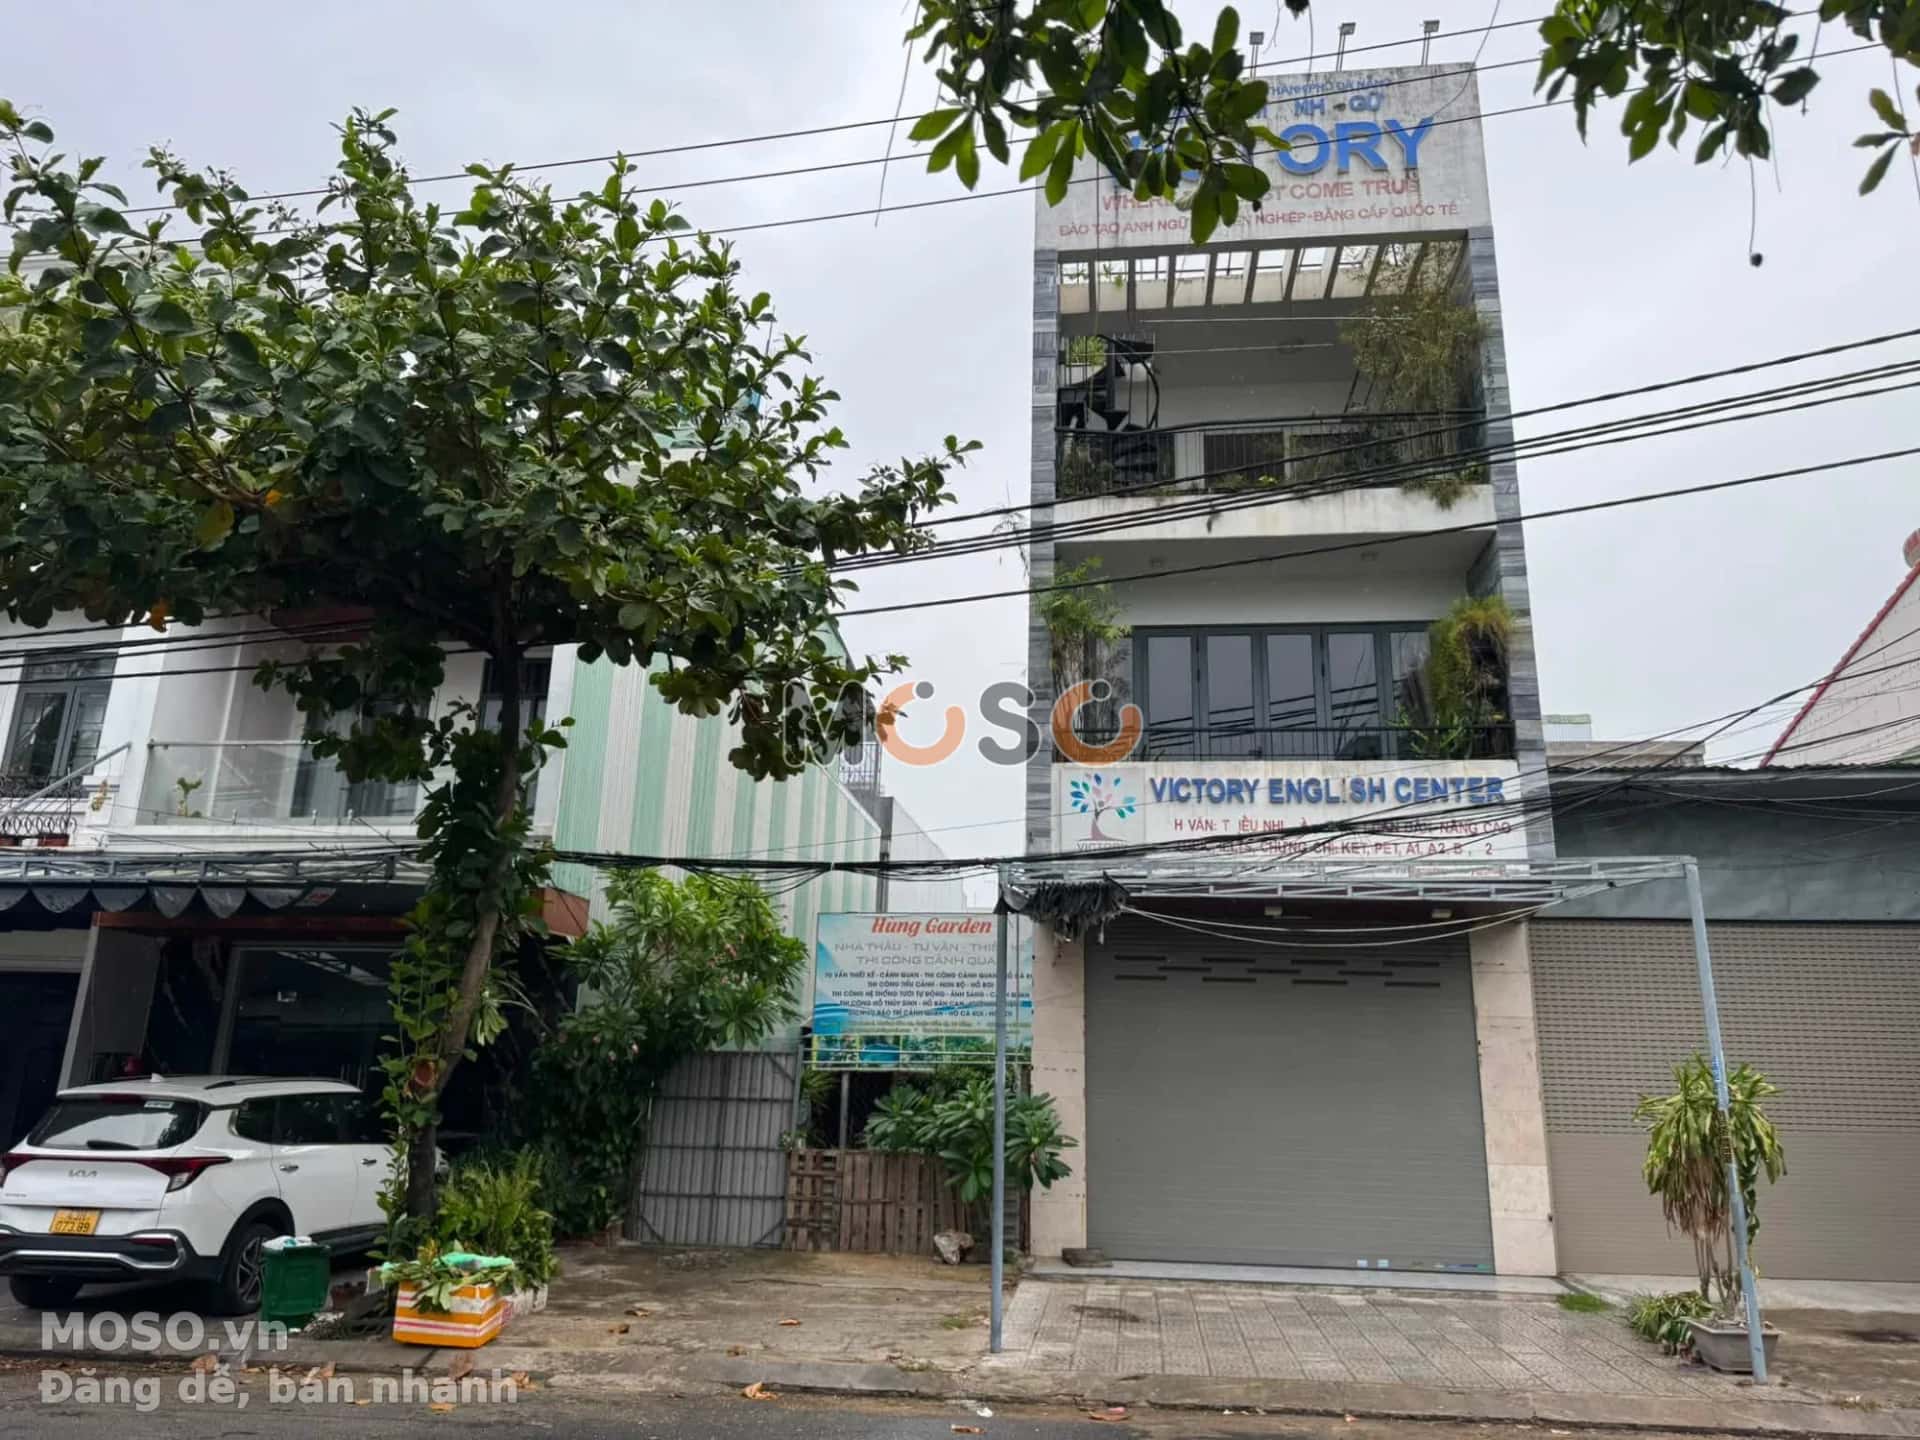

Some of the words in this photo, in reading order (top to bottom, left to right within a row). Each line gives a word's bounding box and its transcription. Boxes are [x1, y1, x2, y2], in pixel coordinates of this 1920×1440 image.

[1289, 181, 1354, 200] COME
[1361, 177, 1420, 196] TRUE
[1123, 222, 1154, 234] ANH
[1150, 777, 1260, 805] VICTORY
[1394, 776, 1507, 804] CENTER
[871, 916, 921, 937] Hùng
[926, 917, 993, 934] Garden
[967, 956, 997, 966] QUA
